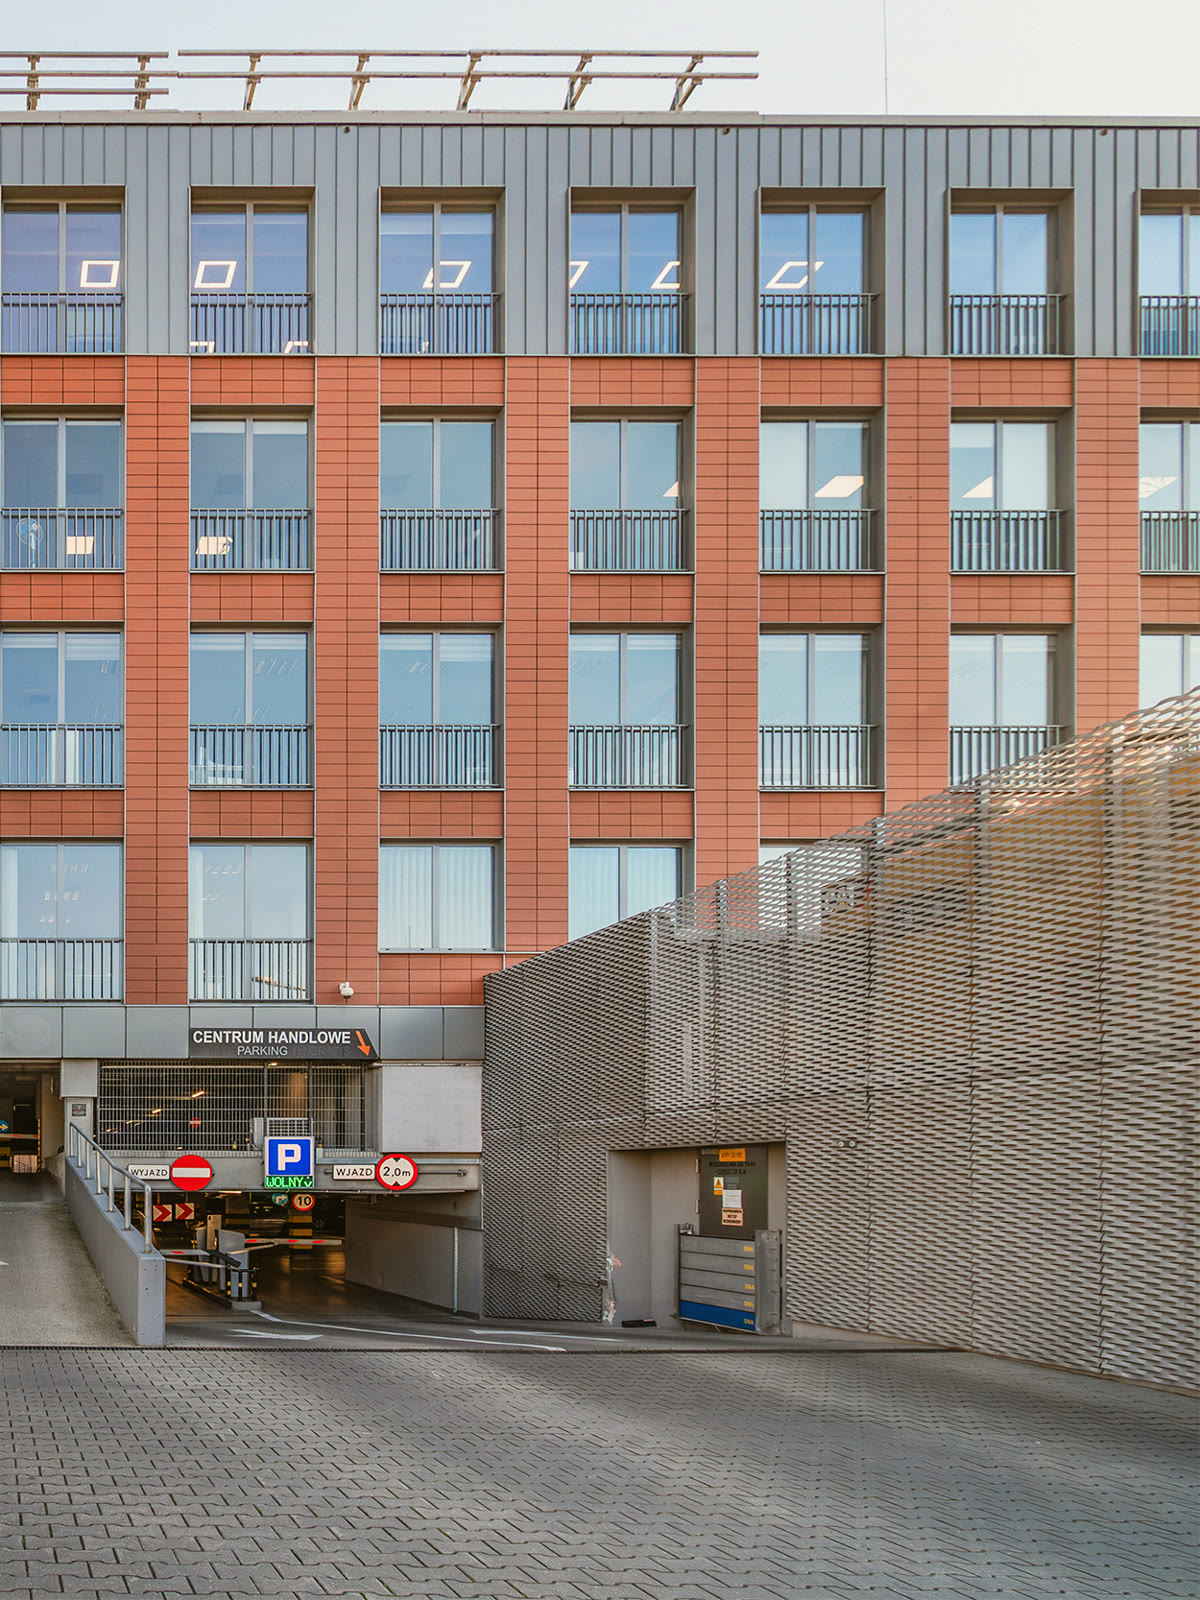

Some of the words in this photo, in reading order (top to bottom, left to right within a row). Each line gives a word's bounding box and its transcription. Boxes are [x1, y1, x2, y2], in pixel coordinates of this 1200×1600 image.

[193, 1030, 264, 1044] CENTRUM
[268, 1030, 351, 1044] HANDLOWE
[237, 1045, 288, 1056] PARKING
[277, 1143, 301, 1171] P
[130, 1168, 168, 1177] WYJAZD
[335, 1168, 373, 1177] WJAZD
[265, 1176, 304, 1188] WOLNY
[297, 1193, 312, 1206] 10
